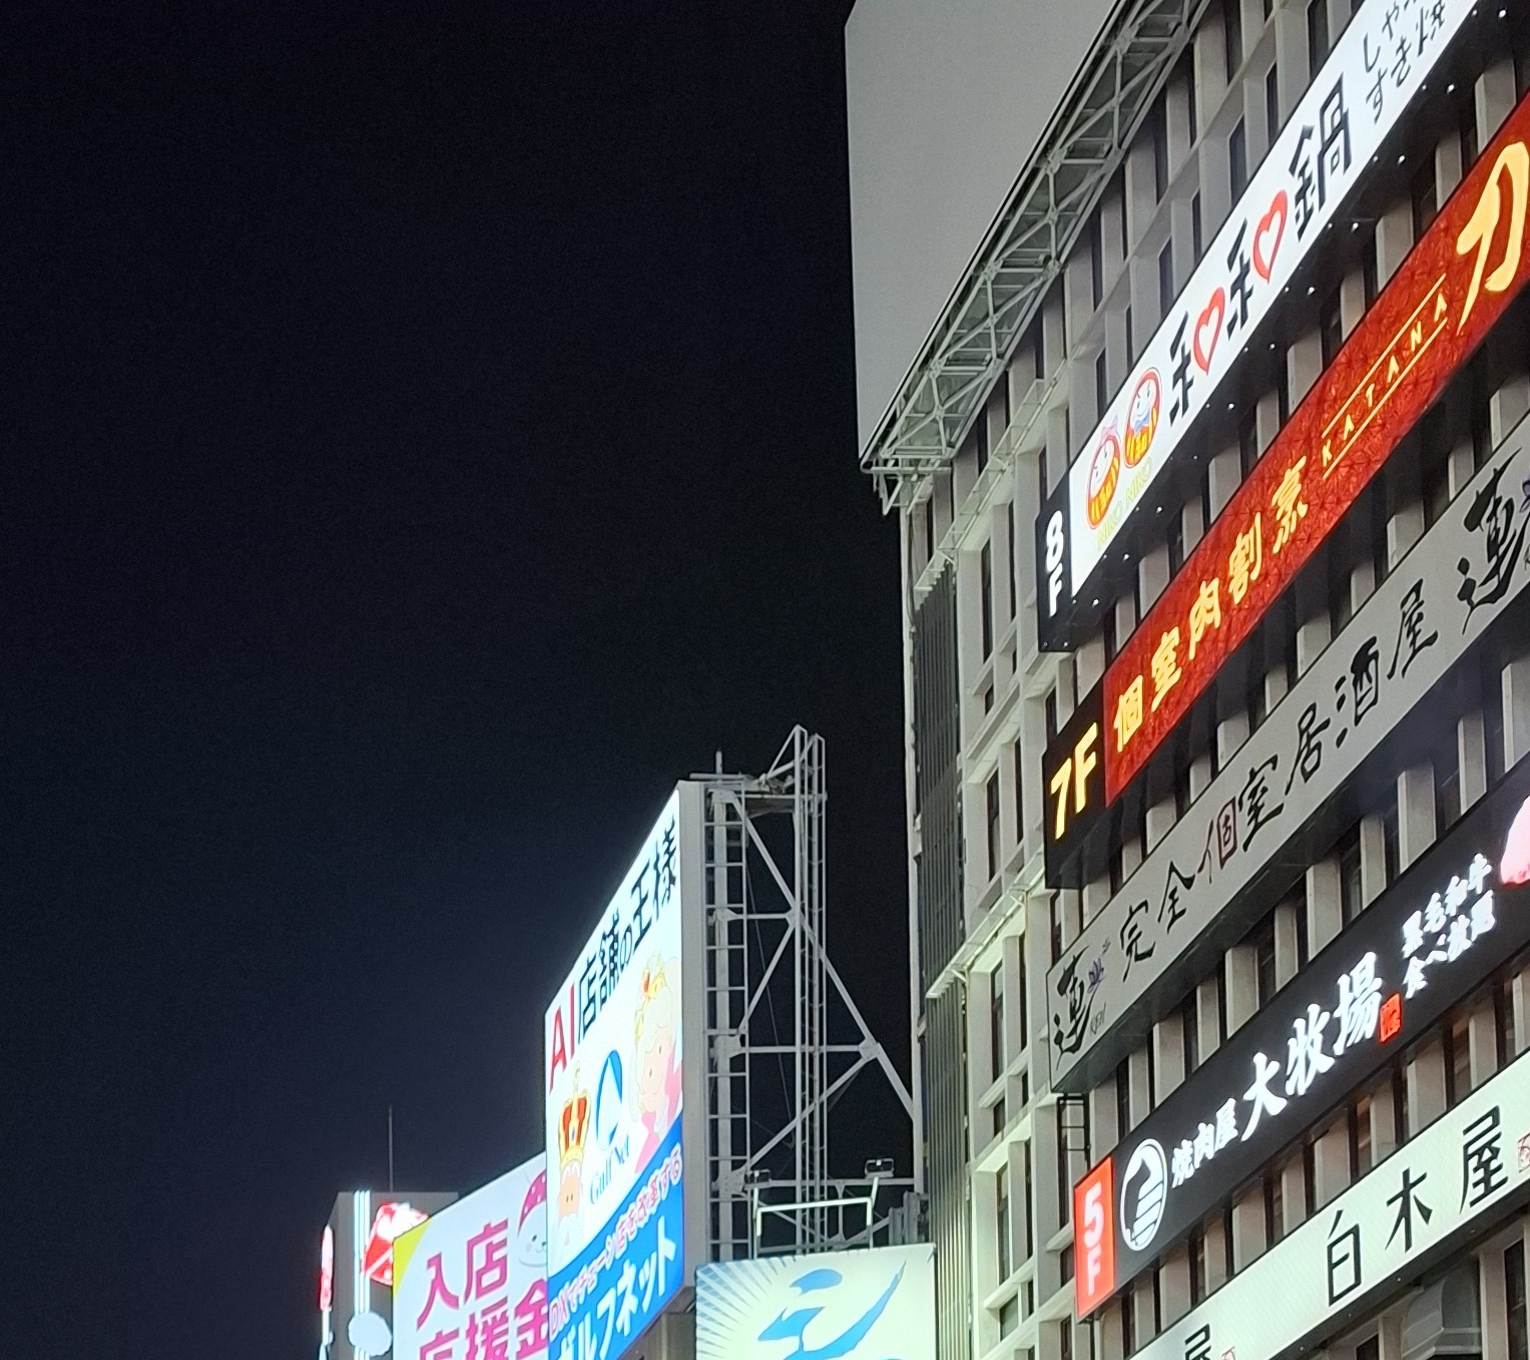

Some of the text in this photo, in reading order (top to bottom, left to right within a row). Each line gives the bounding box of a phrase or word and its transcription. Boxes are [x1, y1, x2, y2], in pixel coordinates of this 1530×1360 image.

[1363, 0, 1417, 73] しゃ
[1320, 300, 1448, 465] KATANA
[1124, 454, 1153, 510] NIKO
[1044, 510, 1065, 617] 8F
[1113, 454, 1309, 753] 個室肉割烹
[1050, 723, 1099, 842] 7F
[1118, 576, 1440, 982] 完全個室居酒屋
[548, 818, 678, 1094] AI店舗の王様
[1170, 950, 1386, 1190] 焼肉屋 大牧場
[416, 1219, 509, 1330] 入店
[1083, 1180, 1105, 1298] 5F
[1326, 1104, 1511, 1308] 白木屋
